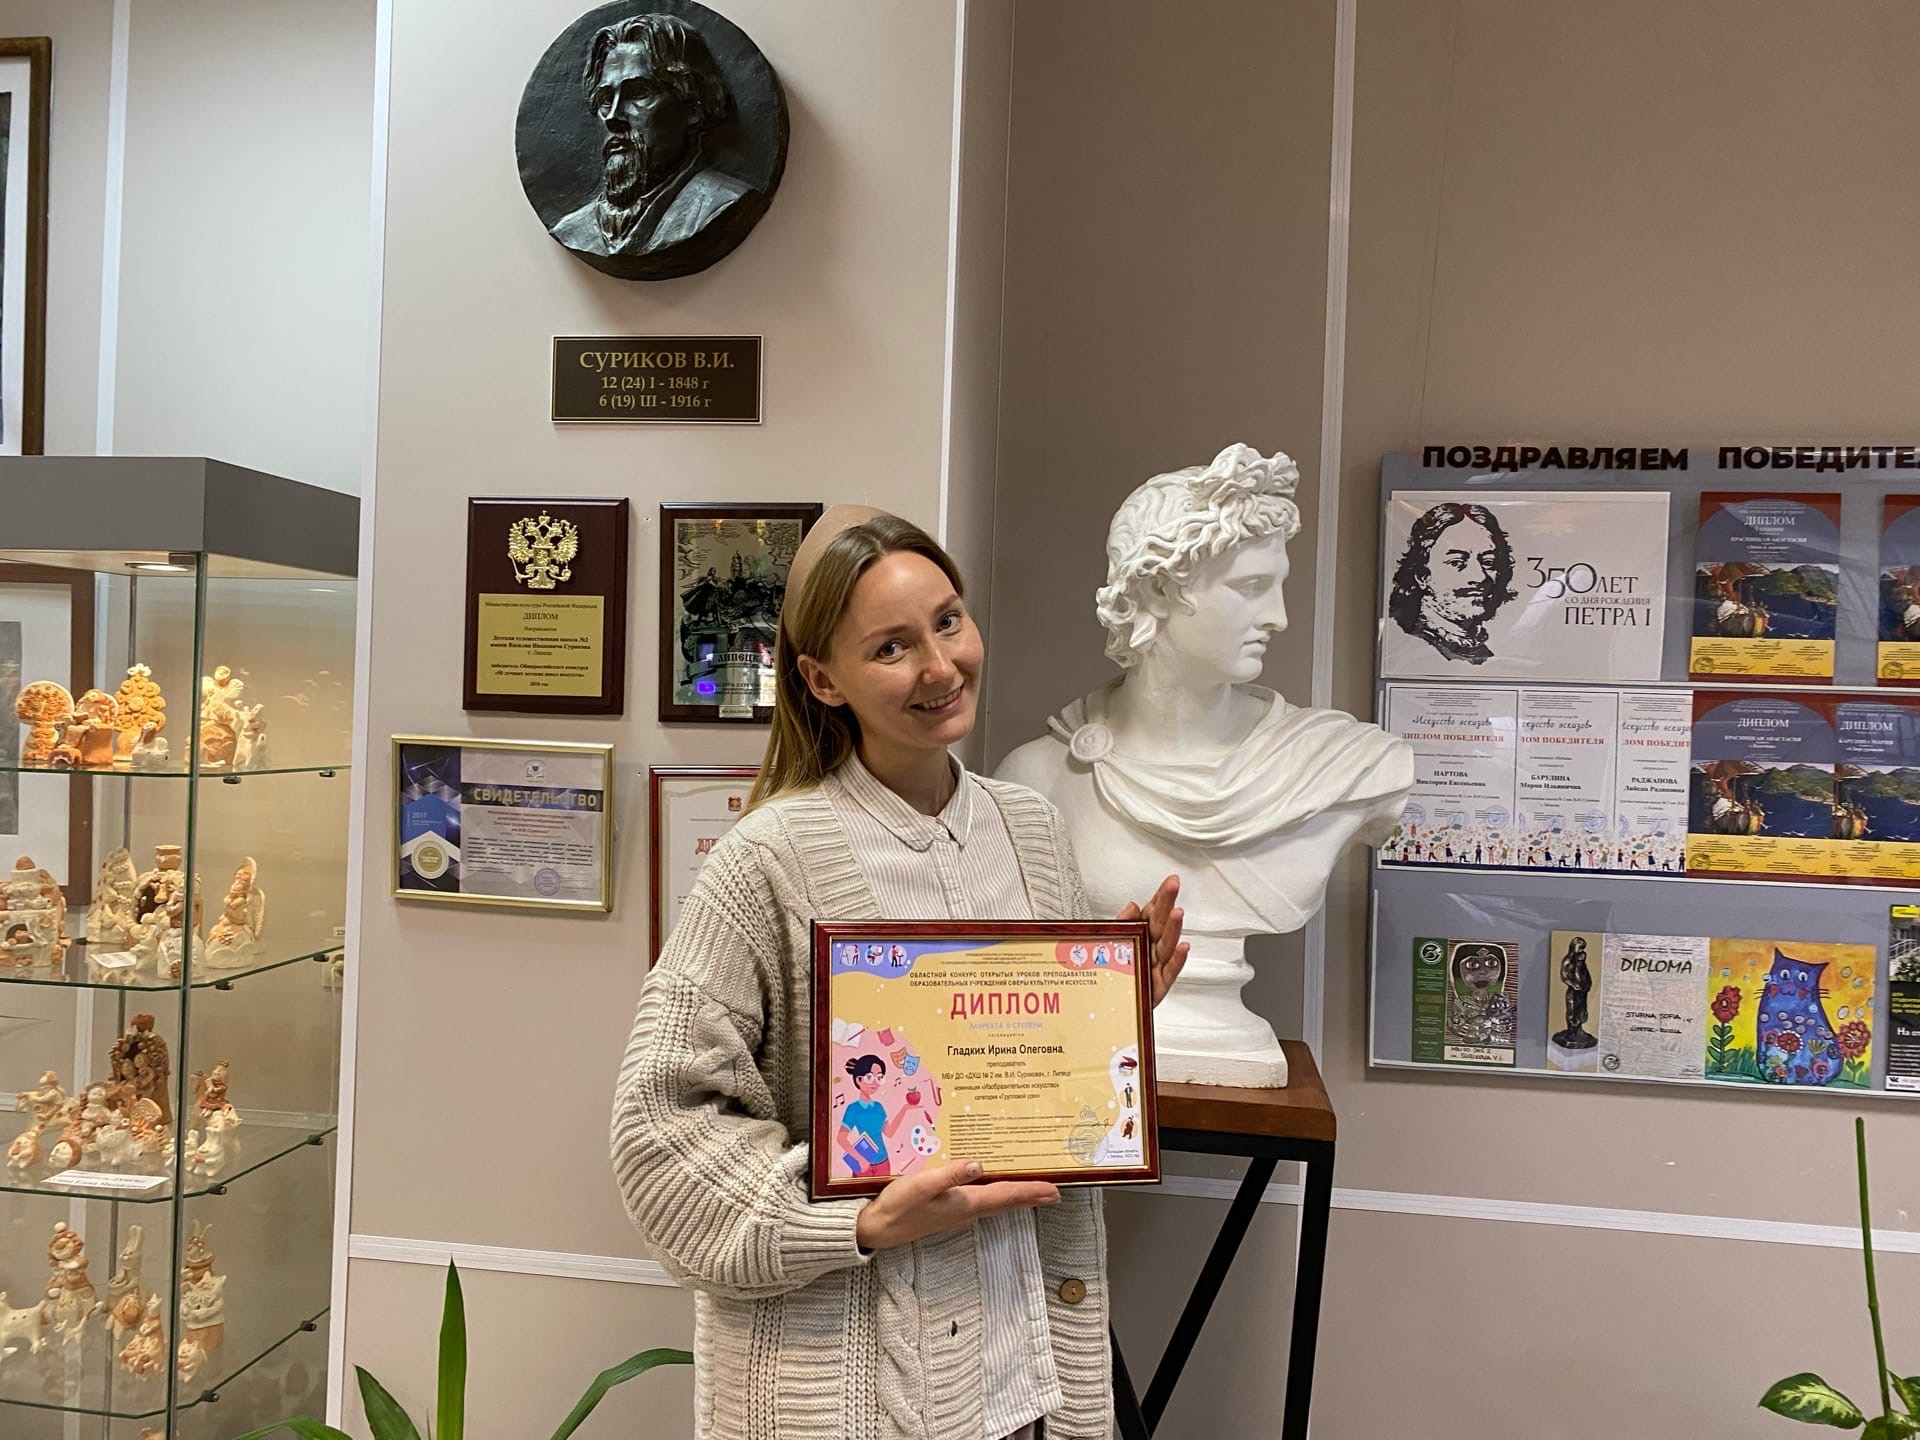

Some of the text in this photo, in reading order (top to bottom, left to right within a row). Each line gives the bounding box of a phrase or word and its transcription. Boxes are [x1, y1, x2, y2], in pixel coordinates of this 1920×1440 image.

[579, 351, 735, 372] СУРИКОВ В.И.
[601, 377, 617, 389] 12
[621, 376, 645, 392] (24)
[668, 377, 699, 389] 1848
[703, 380, 711, 389] г
[599, 395, 607, 407] 6
[611, 395, 636, 410] (19)
[670, 395, 700, 407] 1916
[704, 399, 712, 407] г
[1423, 446, 1689, 472] ПОЗДРАВЛЯЕМ
[1718, 446, 1920, 473] ПОБЕДИТЕ
[1744, 516, 1795, 526] ДИПЛОМ
[1526, 557, 1639, 599] 350 ЛЕТ
[1580, 597, 1600, 605] ДНЯ
[1601, 597, 1651, 605] РОЖДЕНИЯ
[522, 612, 559, 620] ДИПЛОМ
[1565, 606, 1636, 626] ПЕТРА
[1737, 717, 1790, 728] ДИПЛОМ
[1840, 720, 1893, 731] ДИПЛОМ
[1443, 733, 1505, 742] ПОБЕДИТЕЛЯ
[1542, 736, 1605, 745] ПОБЕДИТЕЛЯ
[473, 788, 597, 807] СВИДЕТЕЛЬСТВО
[1620, 957, 1692, 974] DIPLOMA
[1043, 970, 1098, 978] ПРЕПОДАВАТЕЛЕЙ
[969, 979, 1007, 987] УЧРЕЖДЕНИЙ
[951, 992, 1060, 1020] ДИПЛОМ
[946, 1045, 986, 1057] Гладких
[988, 1044, 1017, 1057] Ирина
[941, 1071, 954, 1080] МБУ
